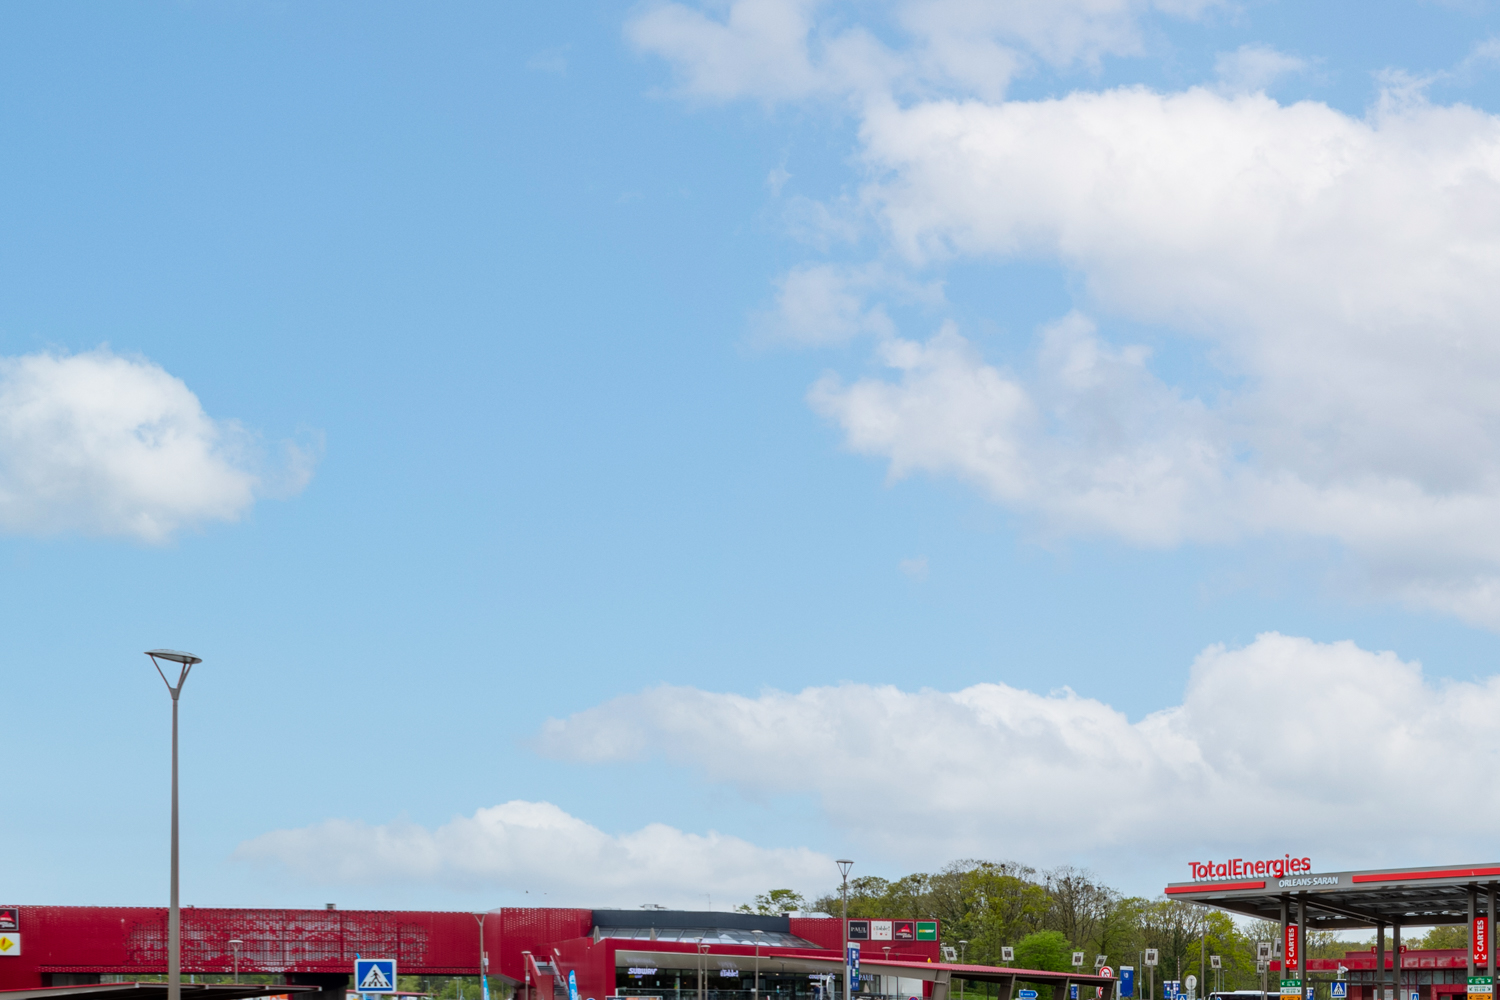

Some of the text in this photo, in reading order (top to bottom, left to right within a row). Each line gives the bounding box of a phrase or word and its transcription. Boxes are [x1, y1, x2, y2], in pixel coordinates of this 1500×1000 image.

[1188, 853, 1311, 878] TotalEnergies
[1278, 876, 1339, 888] ORLEANS-SARAN
[1476, 919, 1484, 952] CARTES
[627, 967, 658, 975] SUBWAY
